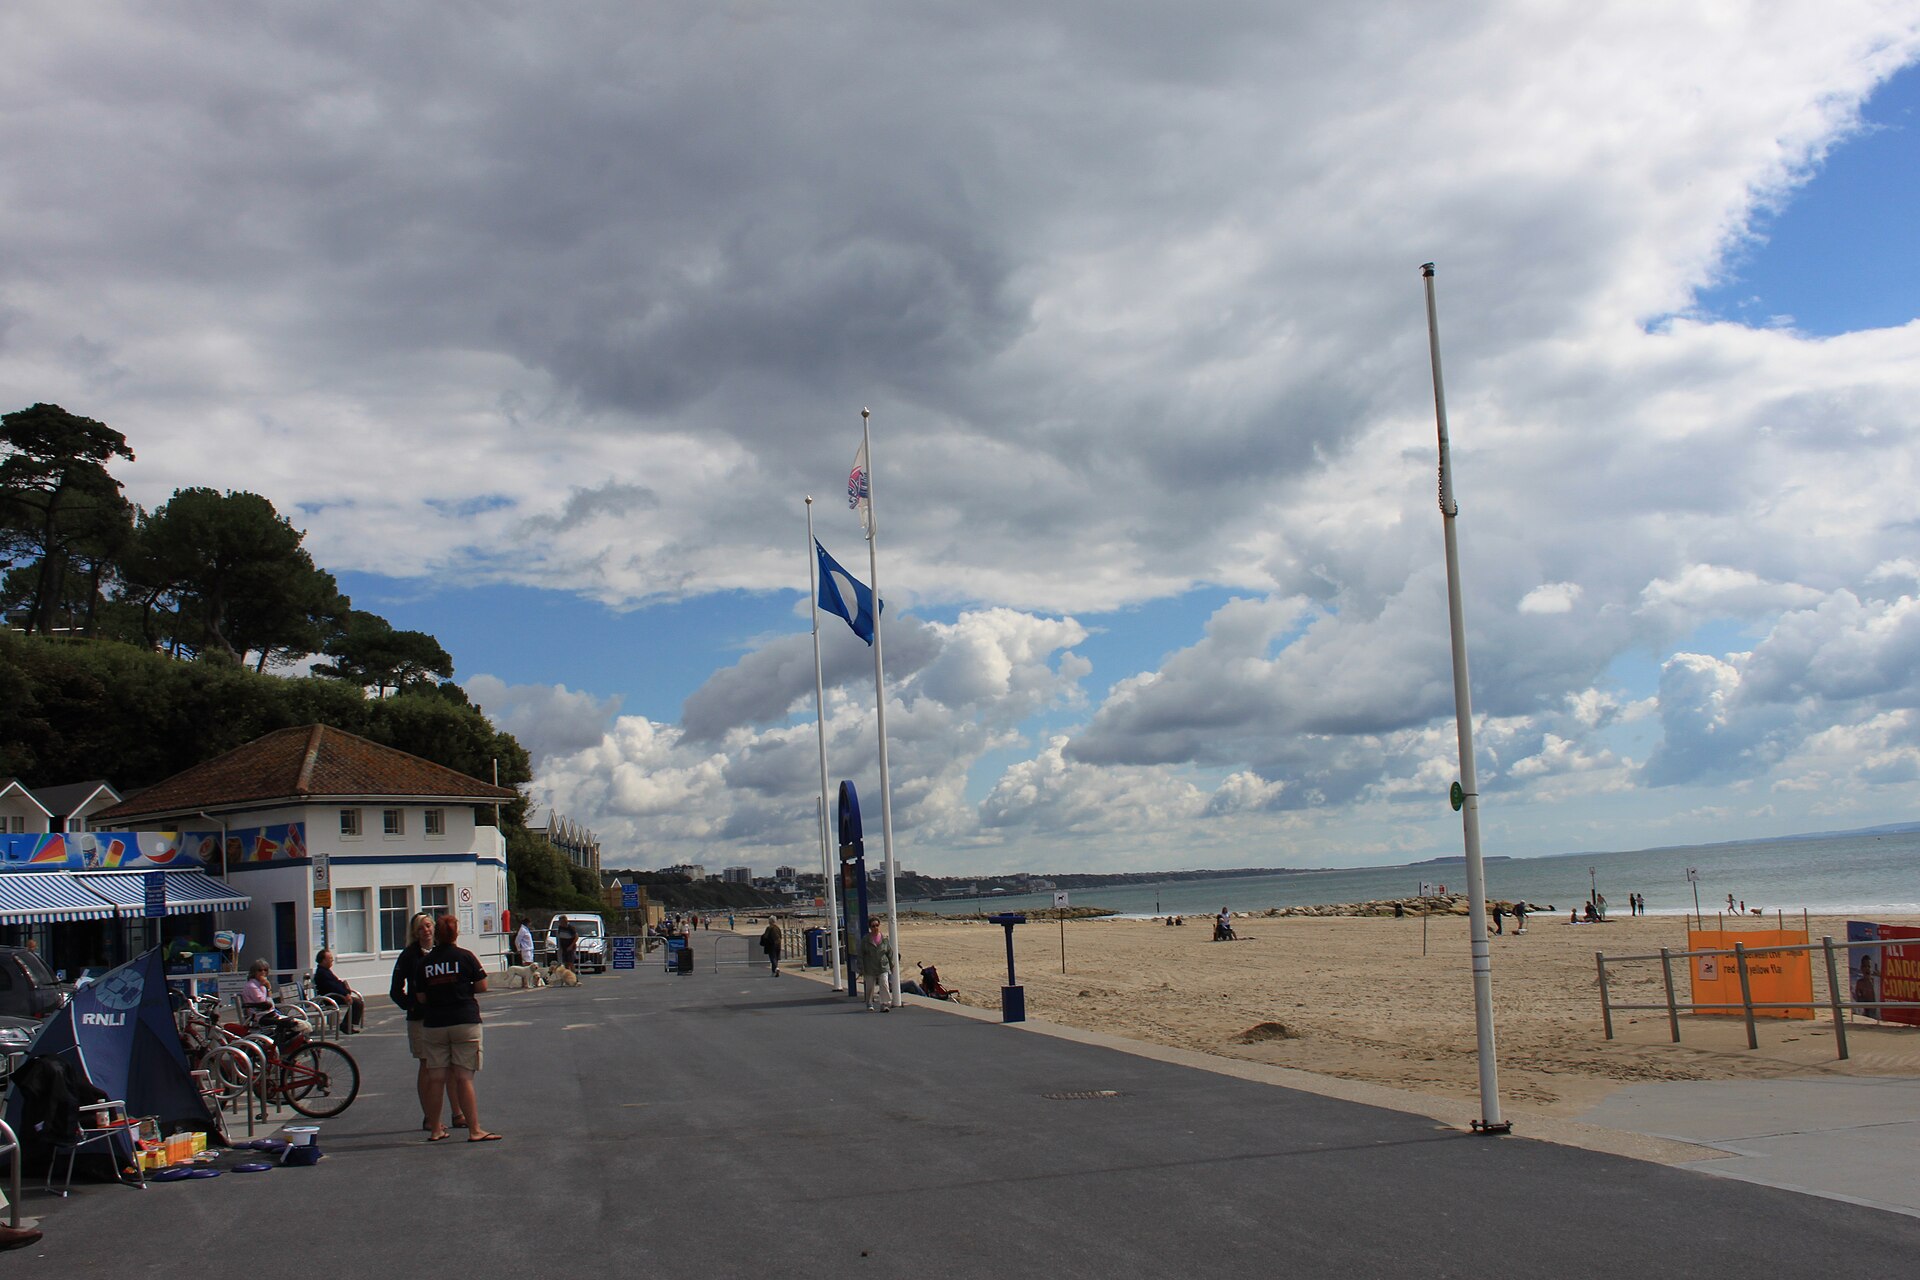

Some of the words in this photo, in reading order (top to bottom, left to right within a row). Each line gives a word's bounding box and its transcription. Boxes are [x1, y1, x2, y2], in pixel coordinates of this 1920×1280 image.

[425, 961, 460, 978] RNLI
[1723, 964, 1736, 974] red
[1749, 964, 1770, 976] yellow
[82, 1013, 126, 1026] RNLI
